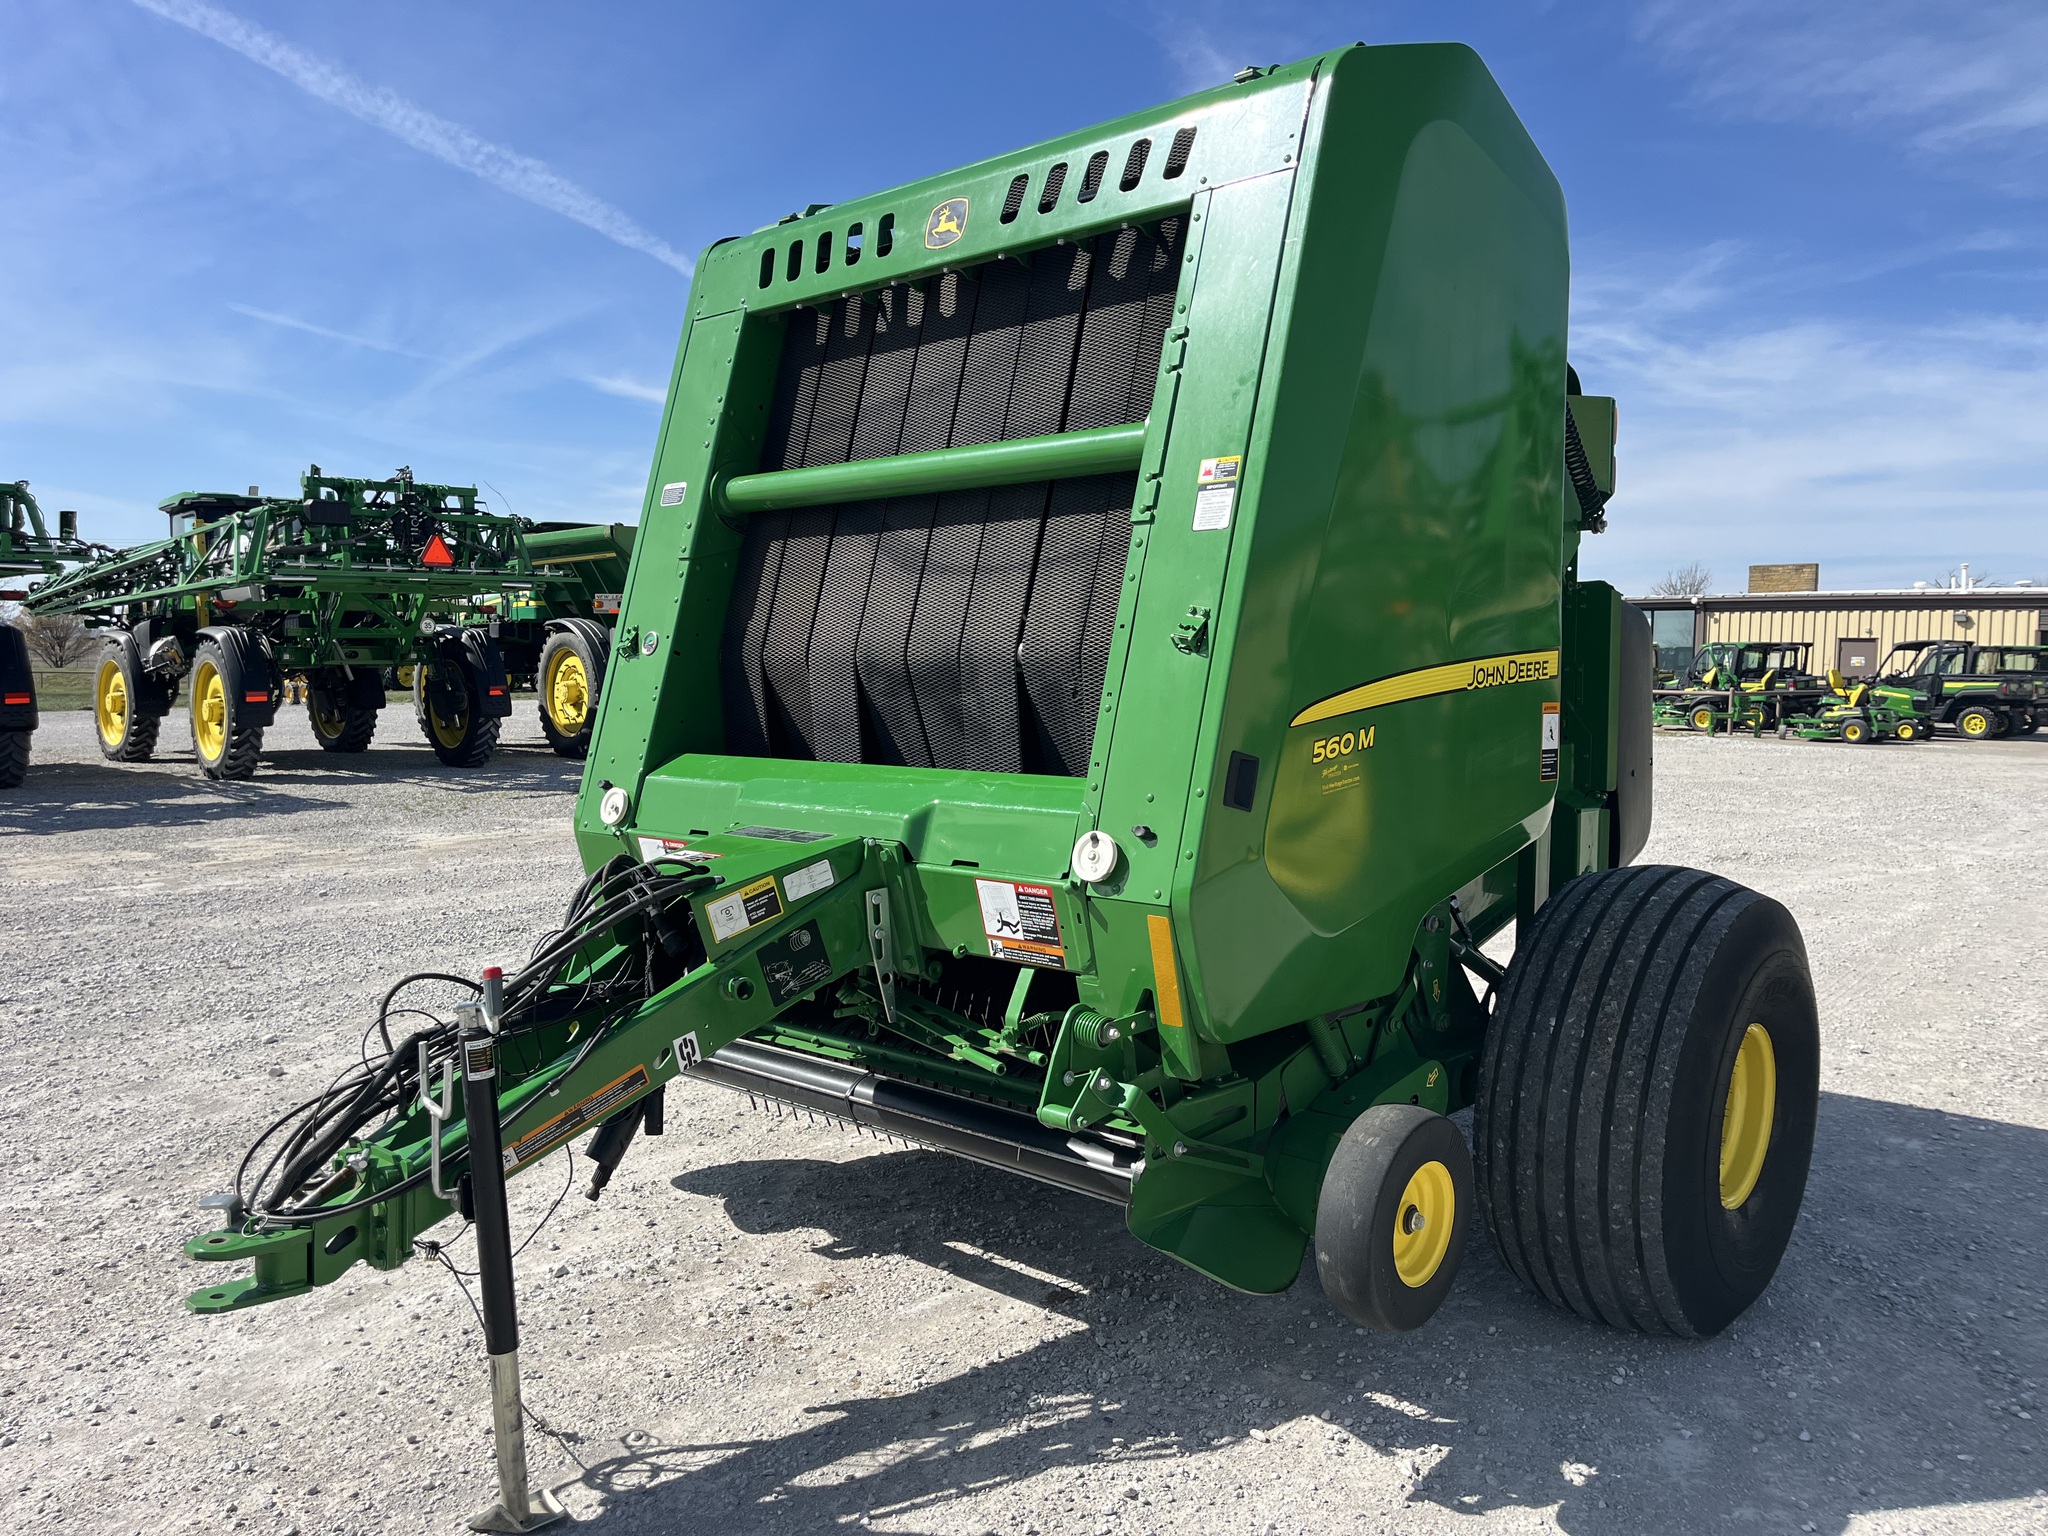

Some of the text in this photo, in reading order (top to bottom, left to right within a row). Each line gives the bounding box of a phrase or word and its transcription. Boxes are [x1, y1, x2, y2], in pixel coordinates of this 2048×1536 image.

[1467, 659, 1549, 688] JOHN DEERE
[1312, 725, 1375, 764] 560 M
[748, 881, 771, 894] CAUTION
[1024, 886, 1048, 895] DANGER
[1021, 944, 1047, 953] WARNING
